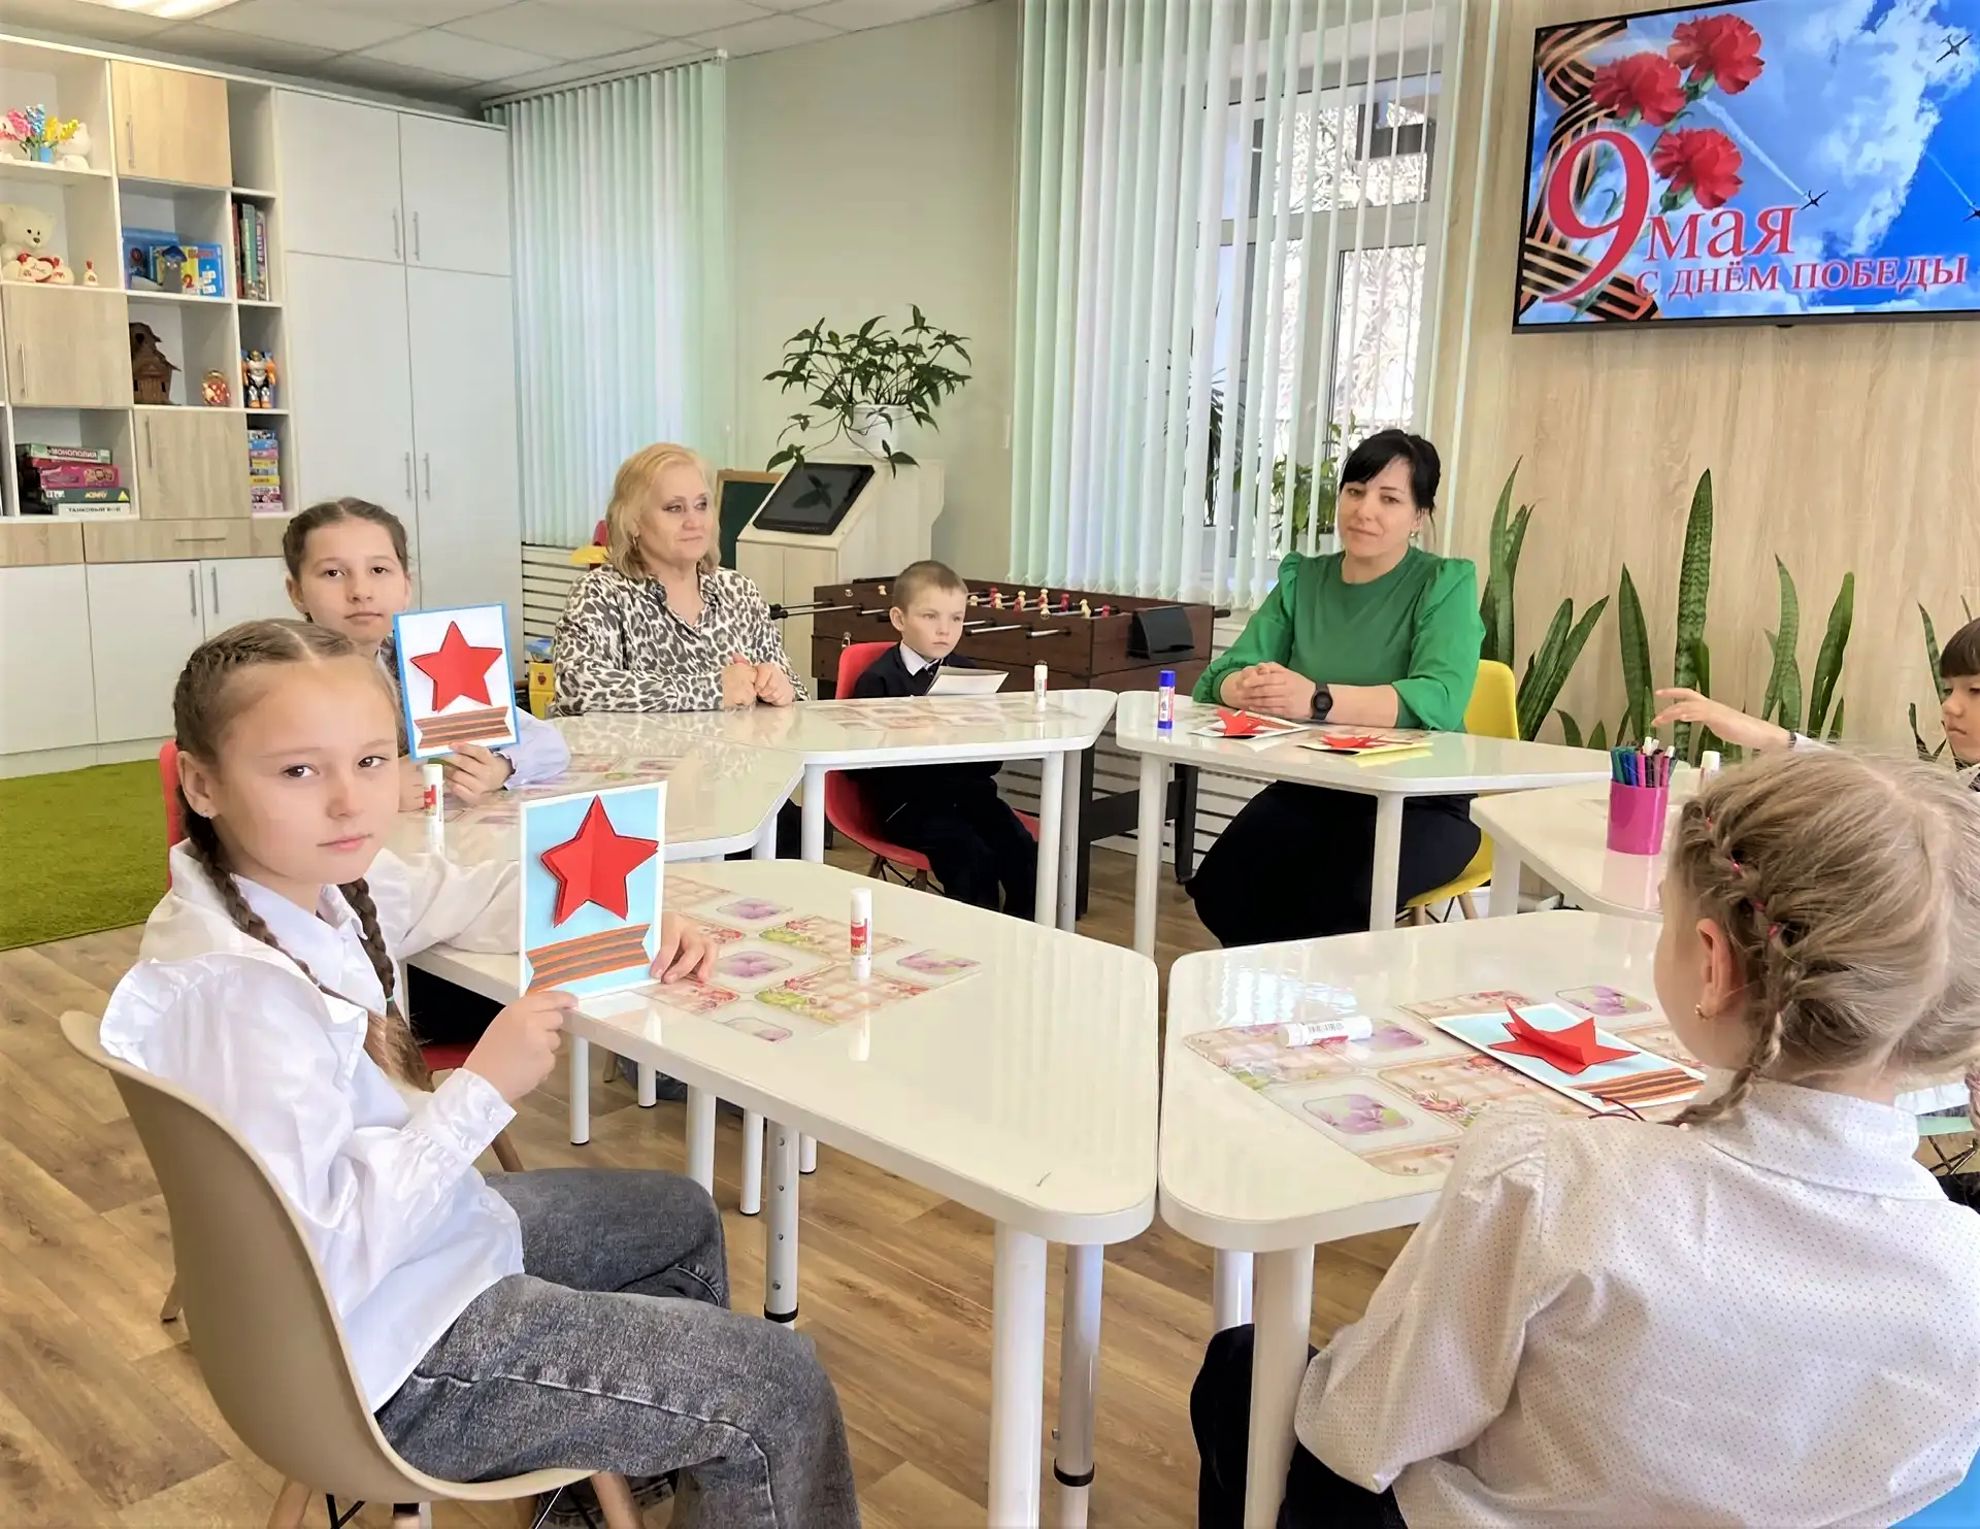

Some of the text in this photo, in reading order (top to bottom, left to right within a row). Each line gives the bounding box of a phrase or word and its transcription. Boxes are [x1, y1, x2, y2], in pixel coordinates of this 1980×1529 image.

[1545, 131, 1799, 302] 9 мая
[1637, 255, 1969, 300] С ДНЁМ ПОБЕДЫ
